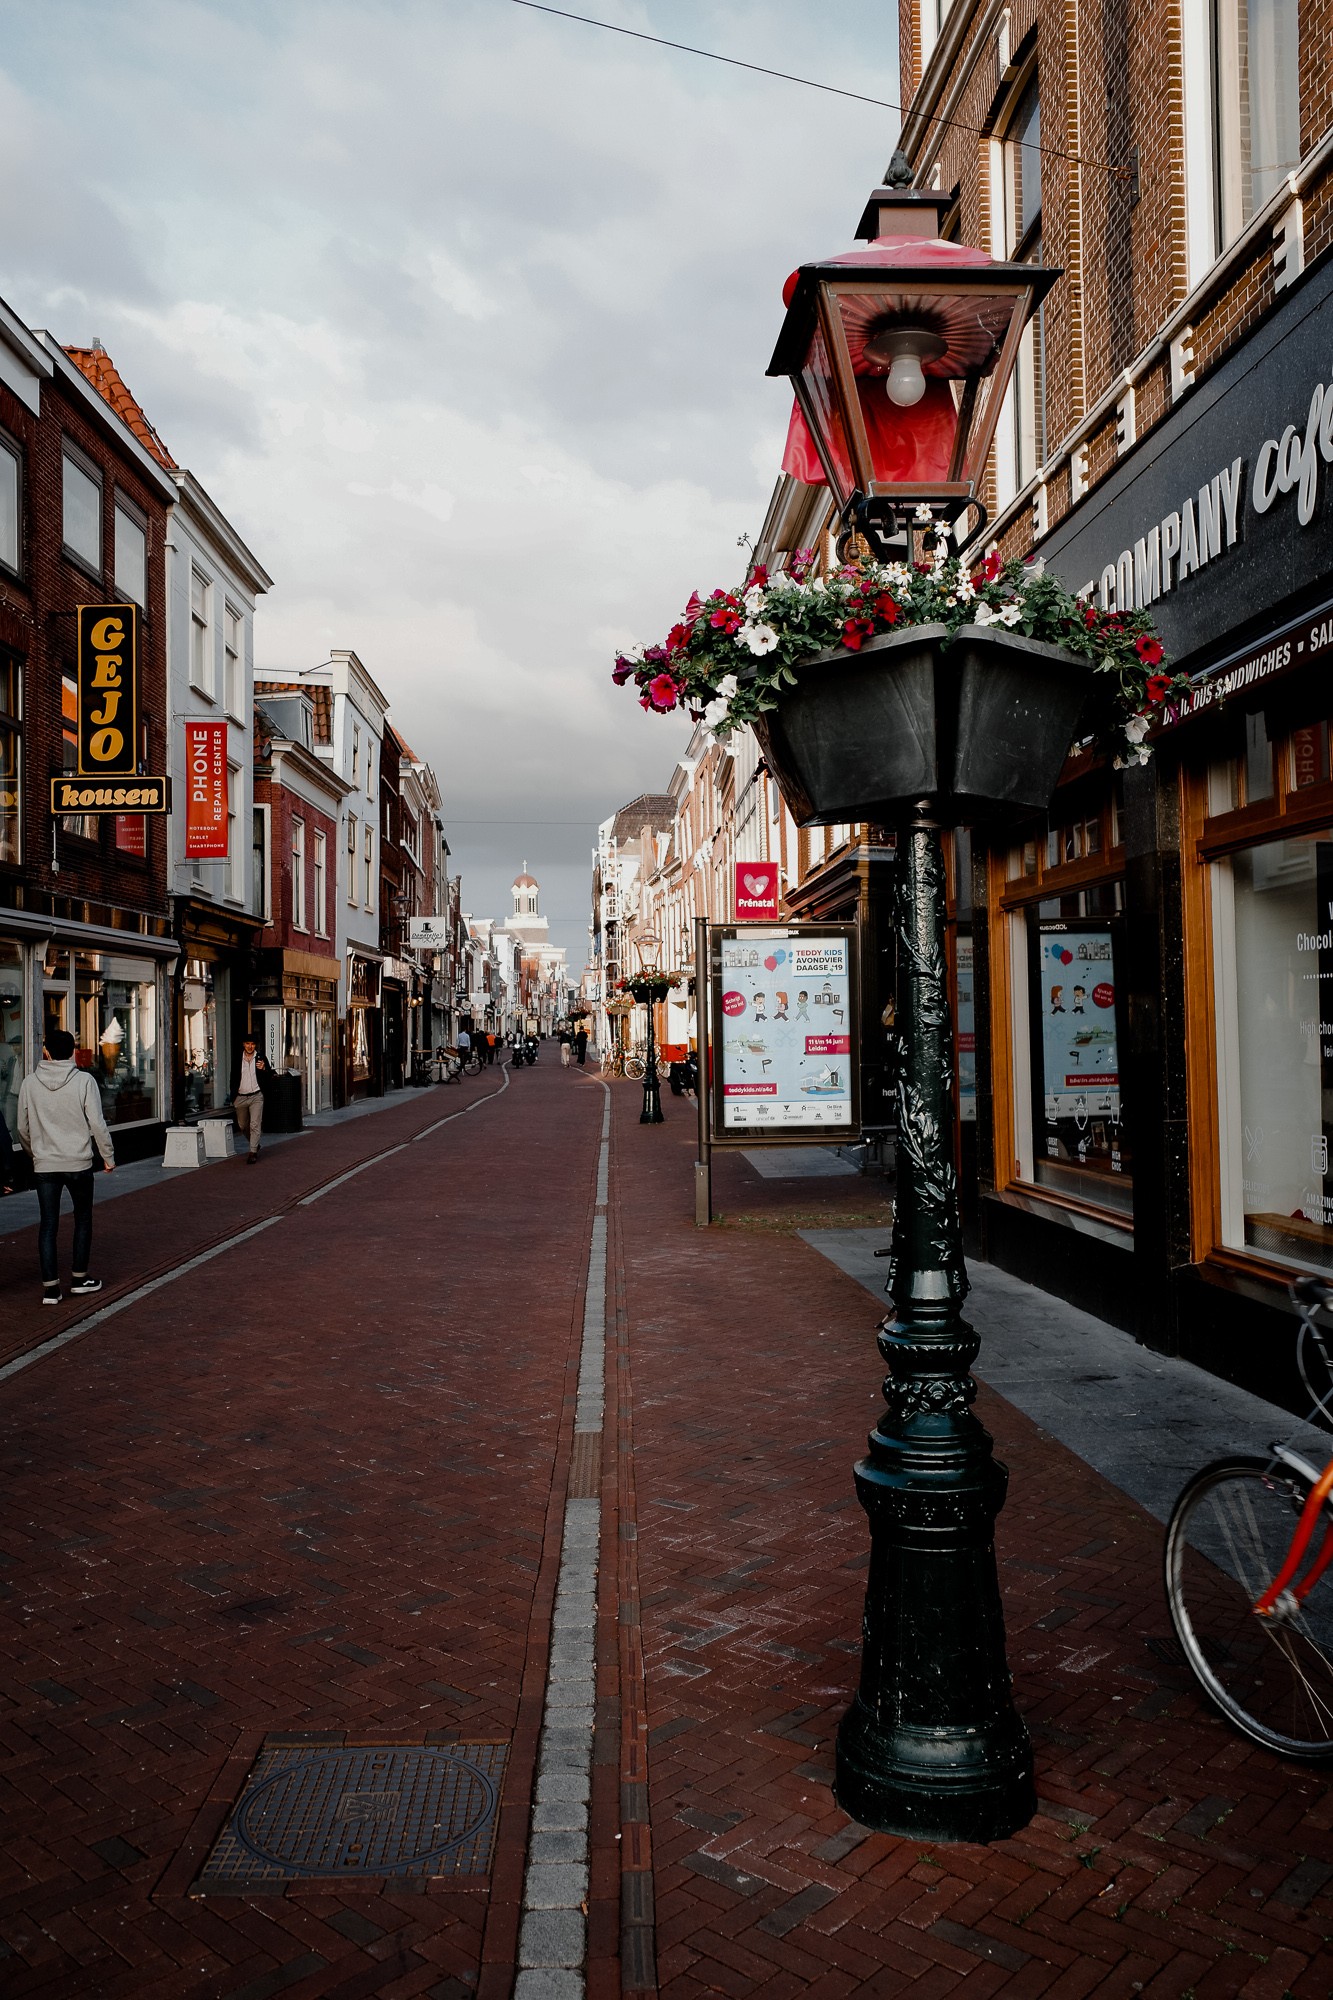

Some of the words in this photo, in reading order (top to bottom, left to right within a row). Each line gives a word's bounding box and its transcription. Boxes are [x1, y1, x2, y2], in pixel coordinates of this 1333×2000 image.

[1100, 456, 1242, 614] COMPANY
[90, 616, 126, 762] GEJO
[193, 730, 208, 802] PHONE
[214, 730, 222, 774] CENTER
[60, 784, 159, 806] kousen
[213, 779, 222, 820] REPAIR
[738, 898, 774, 908] Prénatal
[1318, 1021, 1333, 1035] cho
